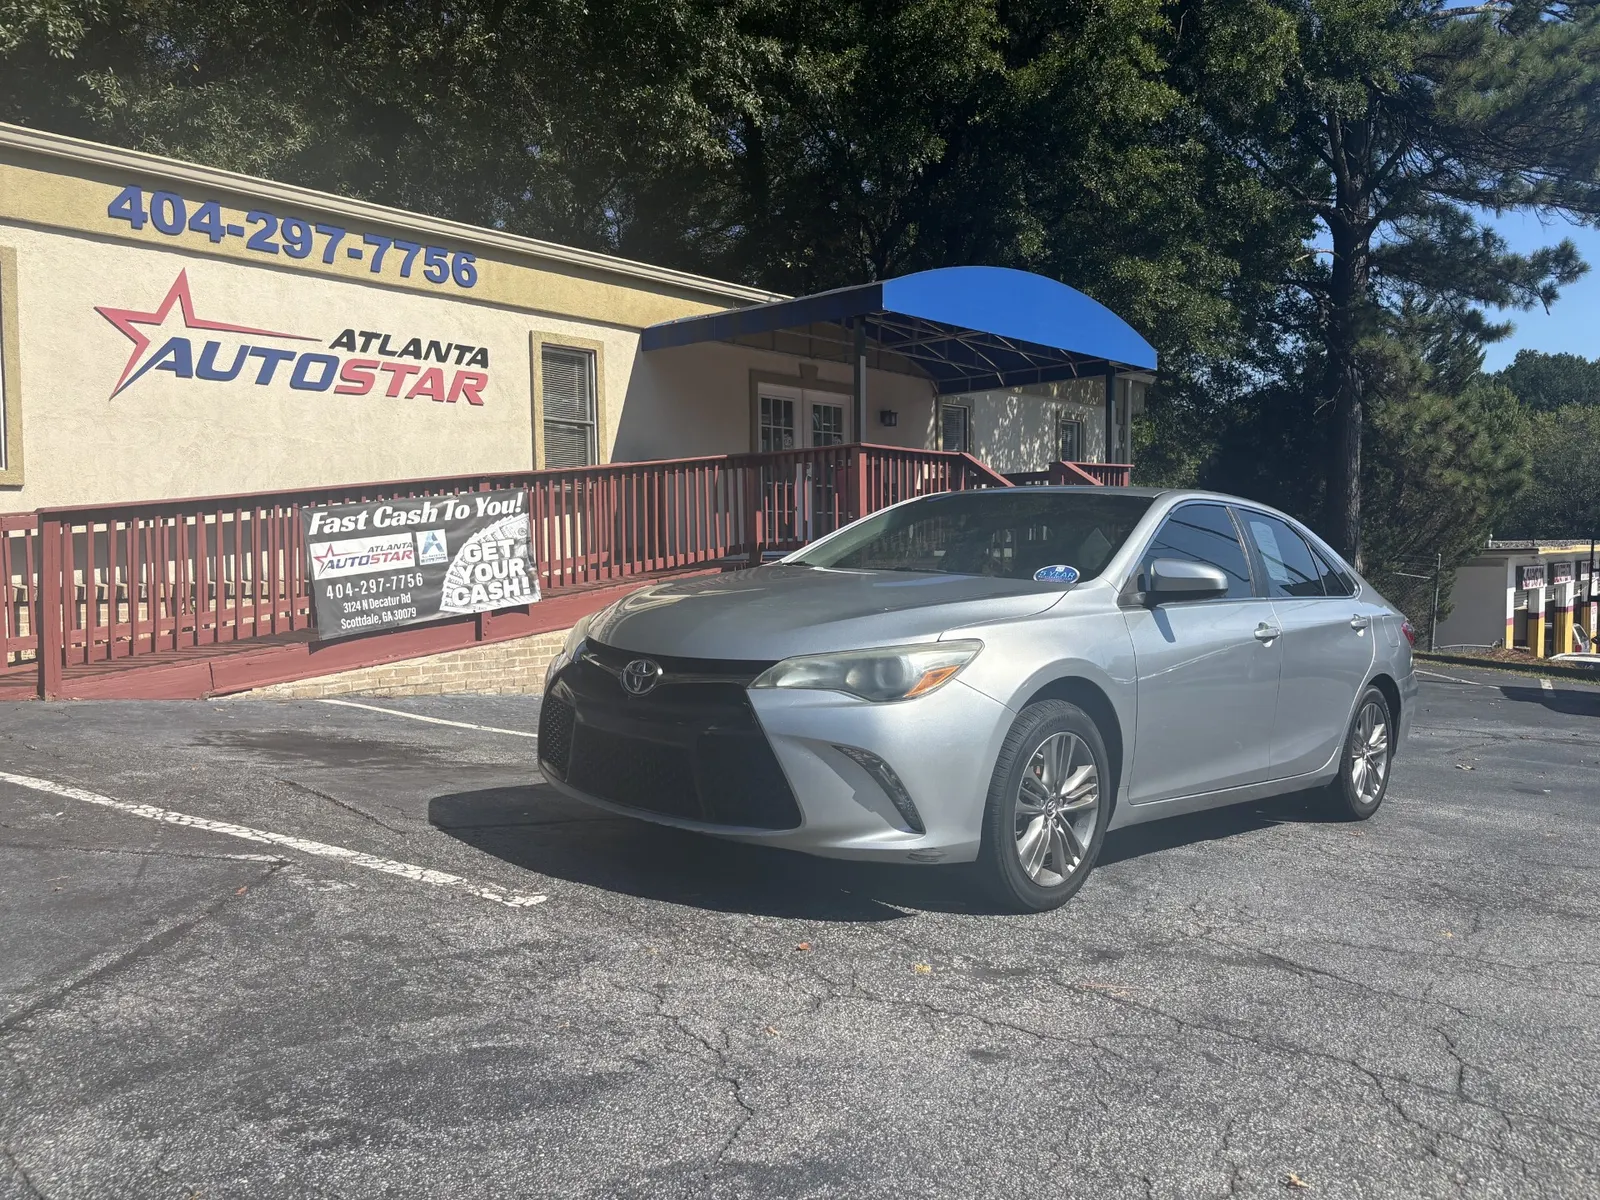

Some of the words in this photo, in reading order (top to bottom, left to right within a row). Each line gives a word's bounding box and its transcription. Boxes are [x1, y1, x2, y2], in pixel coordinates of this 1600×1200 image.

[107, 184, 478, 288] 404-297-7756
[329, 328, 489, 369] ATLANTA
[109, 337, 489, 406] AUTOSTAR
[308, 510, 369, 536] Fast
[372, 501, 438, 528] Cash
[443, 499, 470, 520] To
[475, 492, 523, 517] You!
[367, 541, 413, 554] ATLANTA
[463, 539, 514, 563] GET
[320, 549, 414, 577] AUTOSTAR
[457, 558, 526, 585] YOUR
[326, 572, 423, 600] 404-297-7756
[452, 576, 531, 606] CASH!
[343, 600, 361, 613] 3124
[362, 597, 368, 611] N
[369, 595, 400, 608] Decatur
[400, 592, 411, 604] Rd
[340, 613, 382, 629] Scottdale,
[382, 611, 393, 622] GA
[393, 607, 417, 620] 30079
